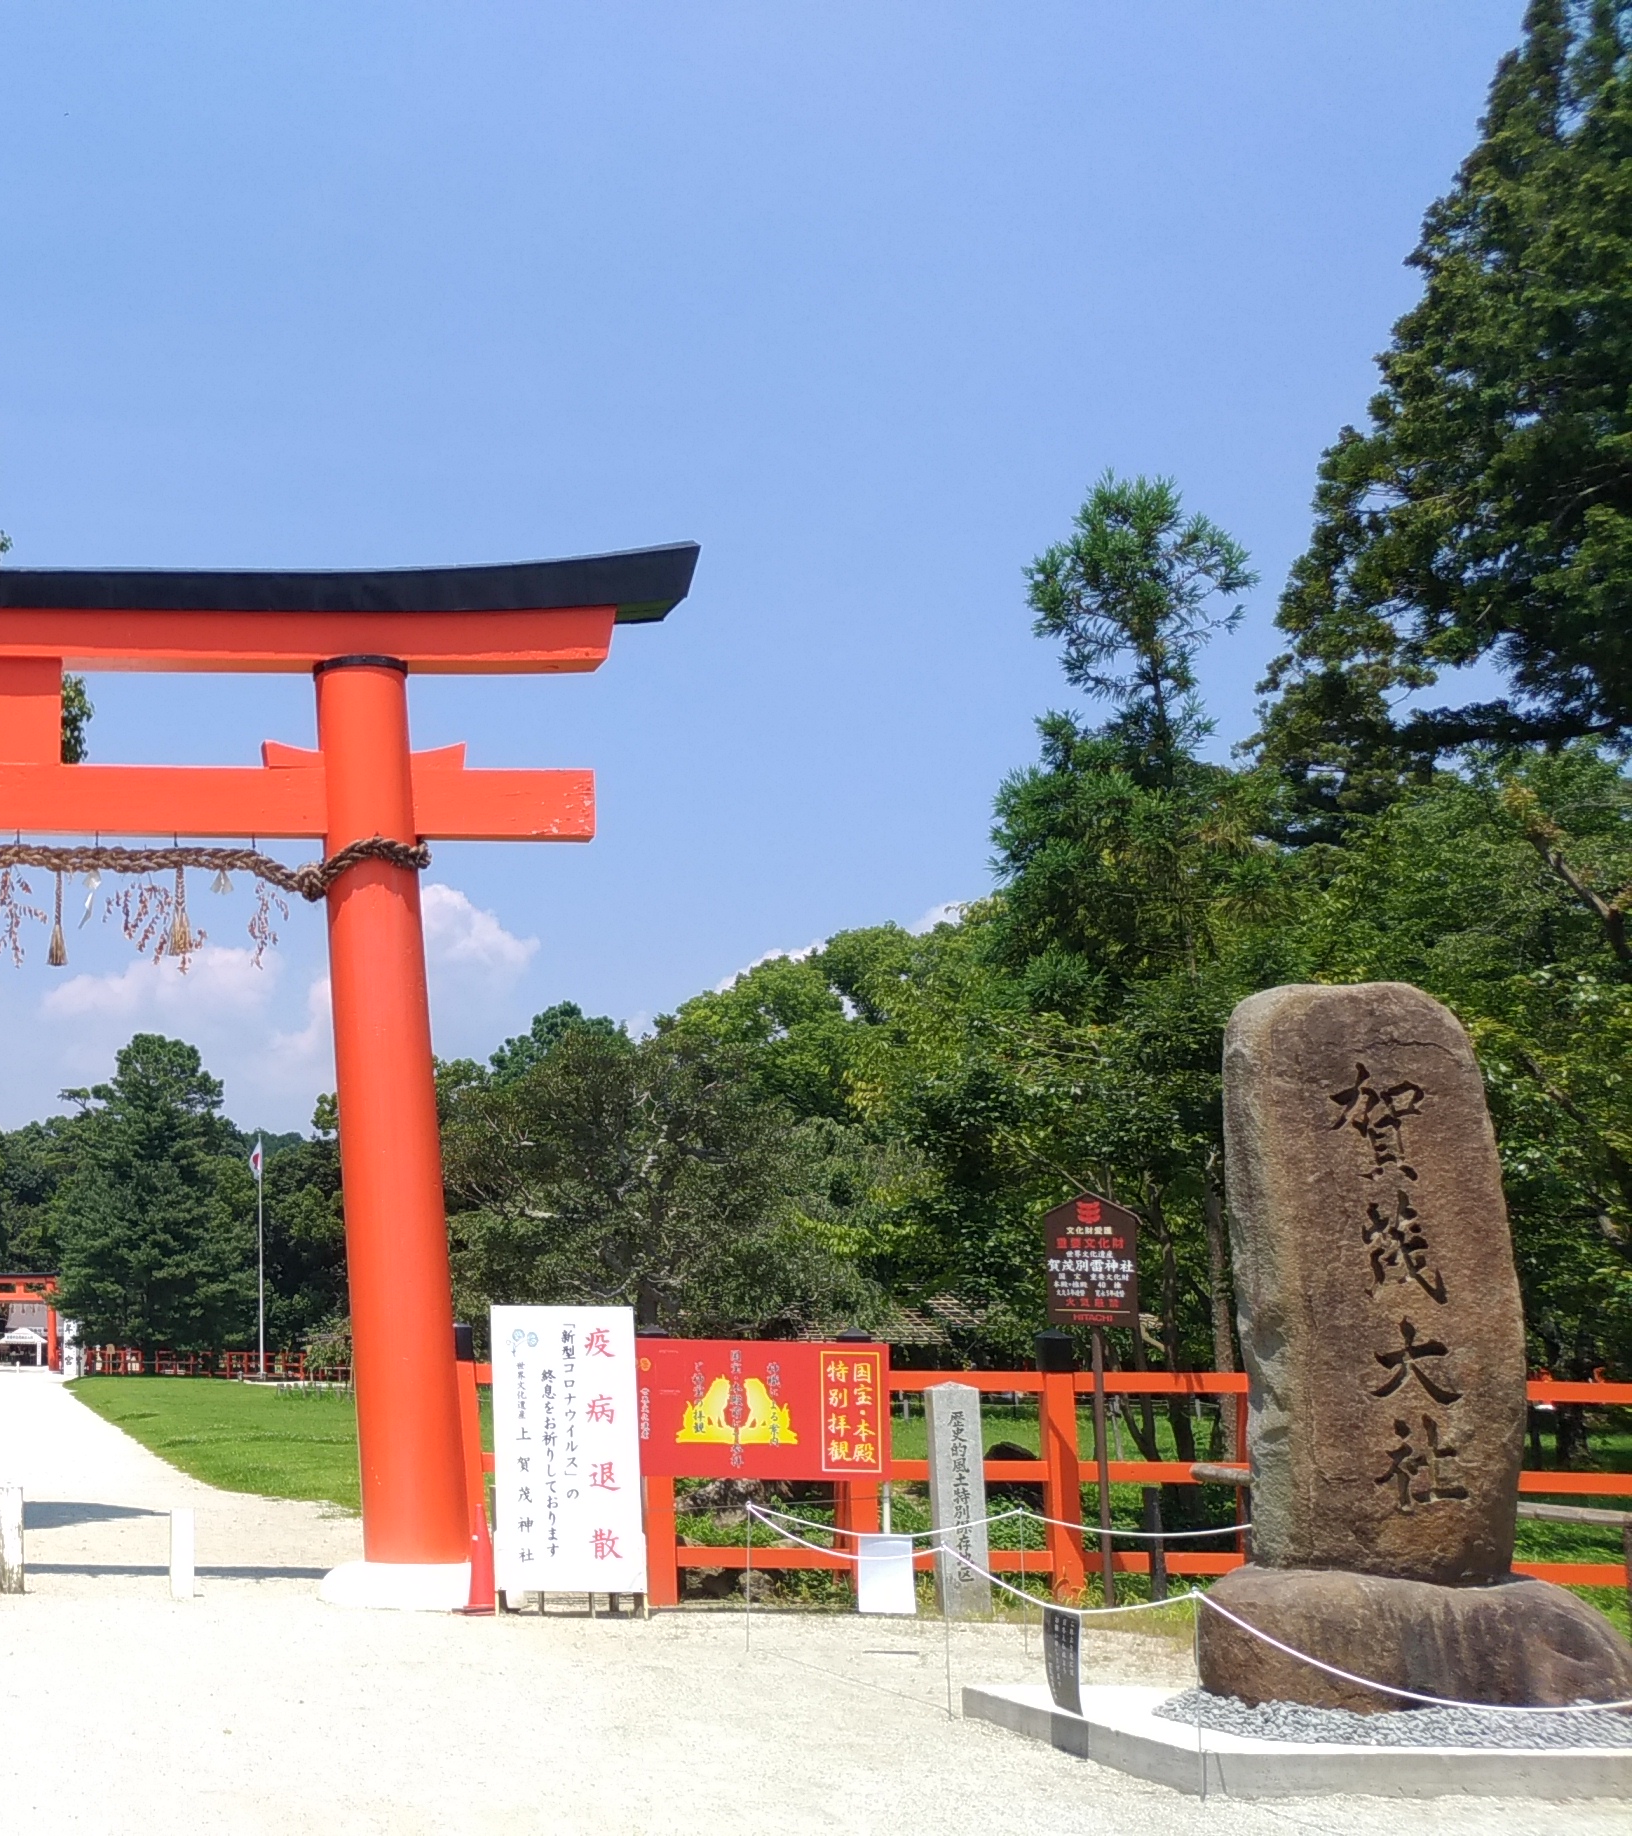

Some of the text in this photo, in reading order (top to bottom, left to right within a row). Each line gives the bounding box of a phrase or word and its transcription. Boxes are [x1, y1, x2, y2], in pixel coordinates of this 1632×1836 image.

[1047, 1258, 1135, 1272] 賀茂別雷神社
[1056, 1237, 1125, 1249] 重要文化財
[1328, 1061, 1472, 1513] 賀茂大社
[1072, 1313, 1115, 1322] HITACHI
[540, 1368, 560, 1558] 終息をお祈りしております
[560, 1323, 580, 1500] 「新型コロナウイルス」の
[583, 1327, 624, 1561] 疫病退散
[826, 1360, 853, 1463] 特別拝観
[852, 1362, 877, 1464] 国宝・本殿
[515, 1426, 535, 1563] 上賀茂神社
